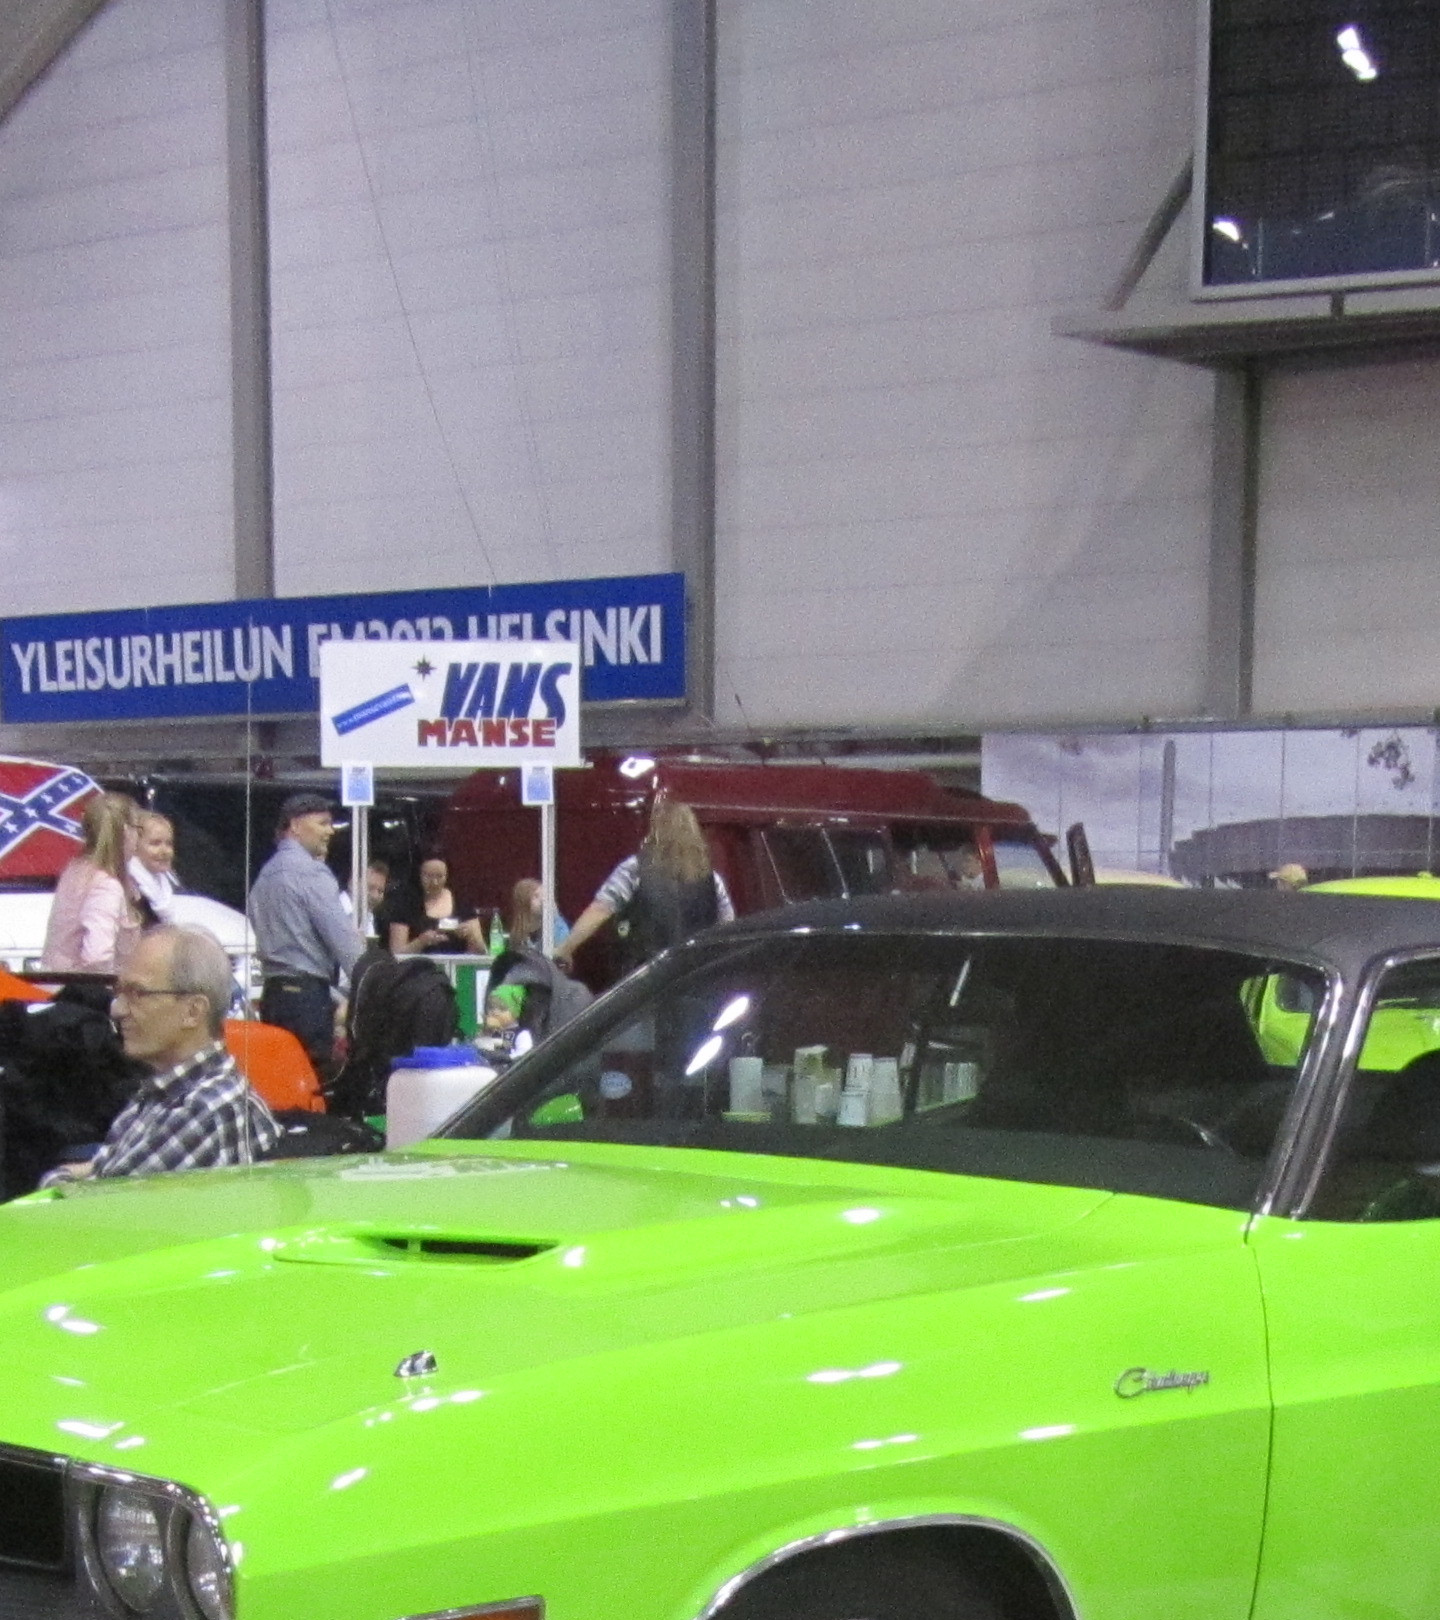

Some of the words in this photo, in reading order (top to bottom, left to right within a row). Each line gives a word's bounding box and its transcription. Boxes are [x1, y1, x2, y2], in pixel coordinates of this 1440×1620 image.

[11, 623, 293, 693] YLEISURHEILUN
[440, 661, 574, 731] VANS
[417, 718, 558, 748] MANSE
